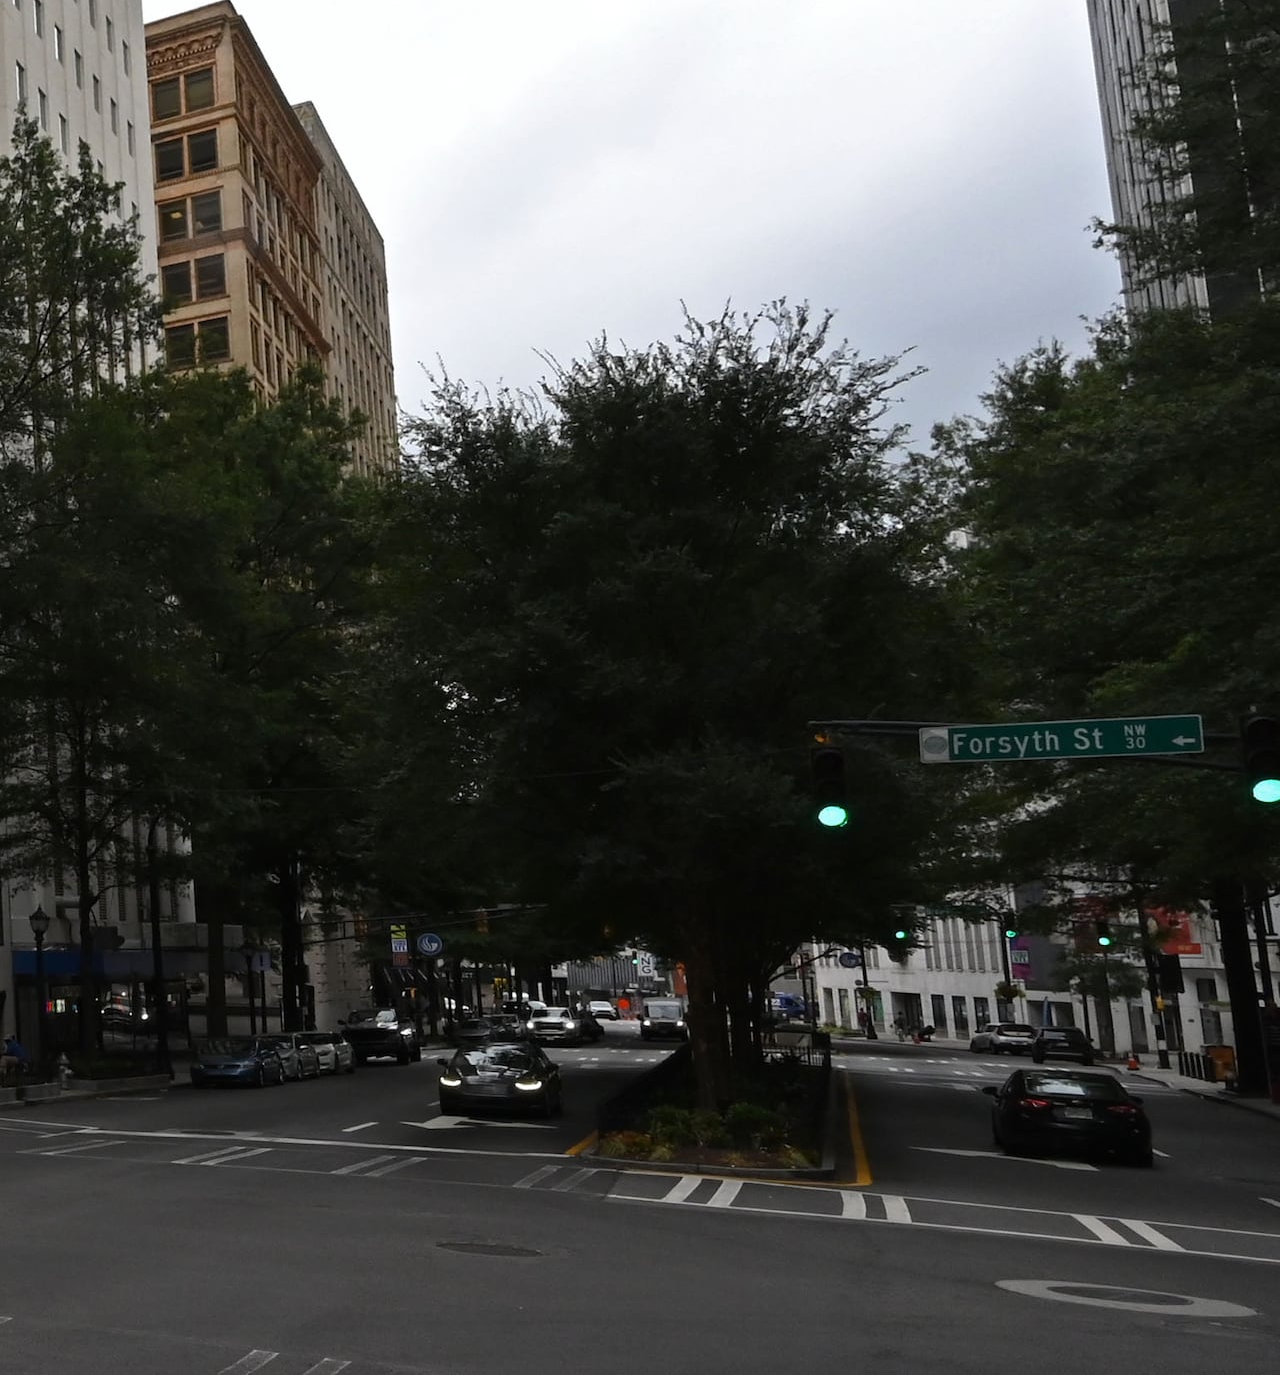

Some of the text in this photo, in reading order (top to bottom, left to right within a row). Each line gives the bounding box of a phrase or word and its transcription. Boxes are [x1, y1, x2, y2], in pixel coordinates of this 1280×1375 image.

[1123, 724, 1146, 736] NW
[952, 728, 1104, 757] Forsyth St
[1125, 737, 1146, 749] 30
